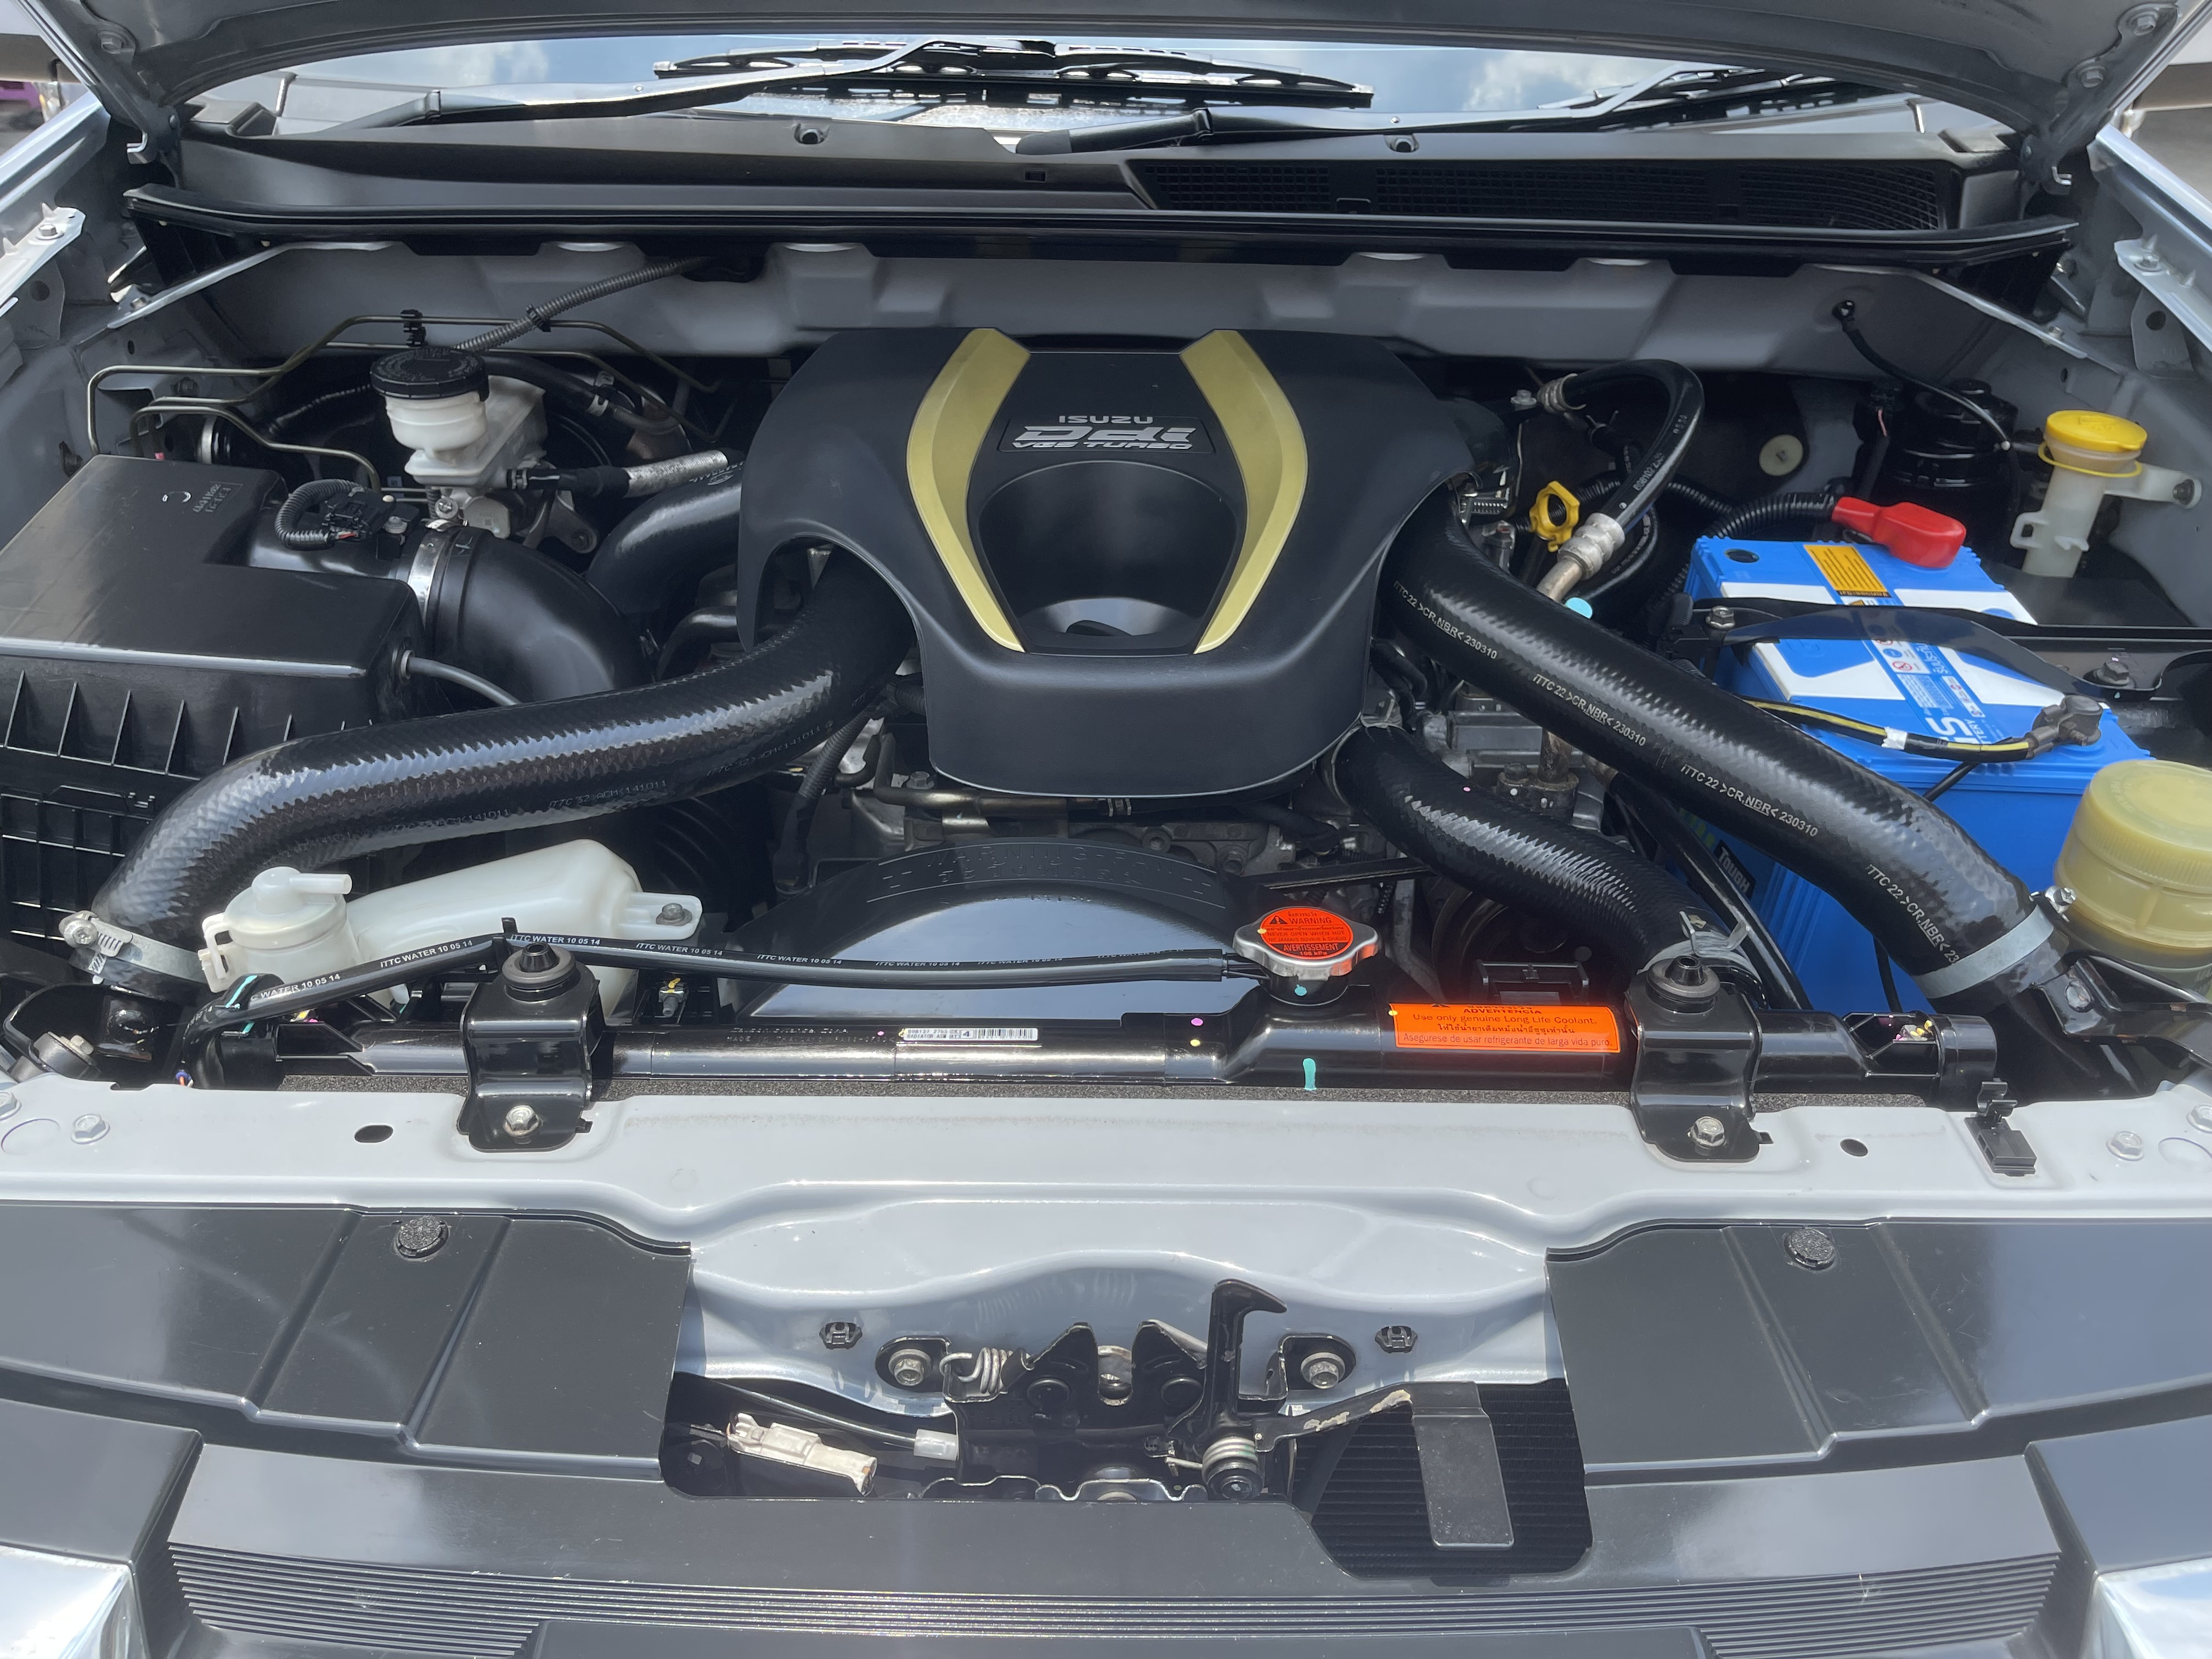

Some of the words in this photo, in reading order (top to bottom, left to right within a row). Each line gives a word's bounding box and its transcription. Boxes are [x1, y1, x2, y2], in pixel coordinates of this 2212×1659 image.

[1059, 415, 1153, 424] ISUZU
[1015, 426, 1197, 442] Ddi
[1407, 595, 1418, 607] 22
[1464, 635, 1497, 659] 230310
[1553, 685, 1566, 698] 22
[1613, 720, 1646, 746] 230310
[1705, 776, 1719, 790] 22
[1779, 811, 1818, 837] 230310
[1719, 846, 1750, 893] TOUGH
[1886, 884, 1904, 899] 22
[532, 935, 565, 944] WATER
[657, 944, 689, 953] WATER
[1283, 943, 1339, 952] AVERTISSEMENT
[402, 949, 437, 962] WATER
[260, 984, 300, 999] WATER
[301, 980, 313, 989] 10
[315, 977, 327, 986] 05
[329, 973, 341, 981] 14
[1504, 1016, 1530, 1024] Long
[1403, 1032, 1447, 1043] Asegurese
[1450, 1034, 1460, 1042] de
[1484, 1035, 1532, 1046] refrigerante
[1548, 1037, 1568, 1047] larga
[1571, 1037, 1588, 1046] vida
